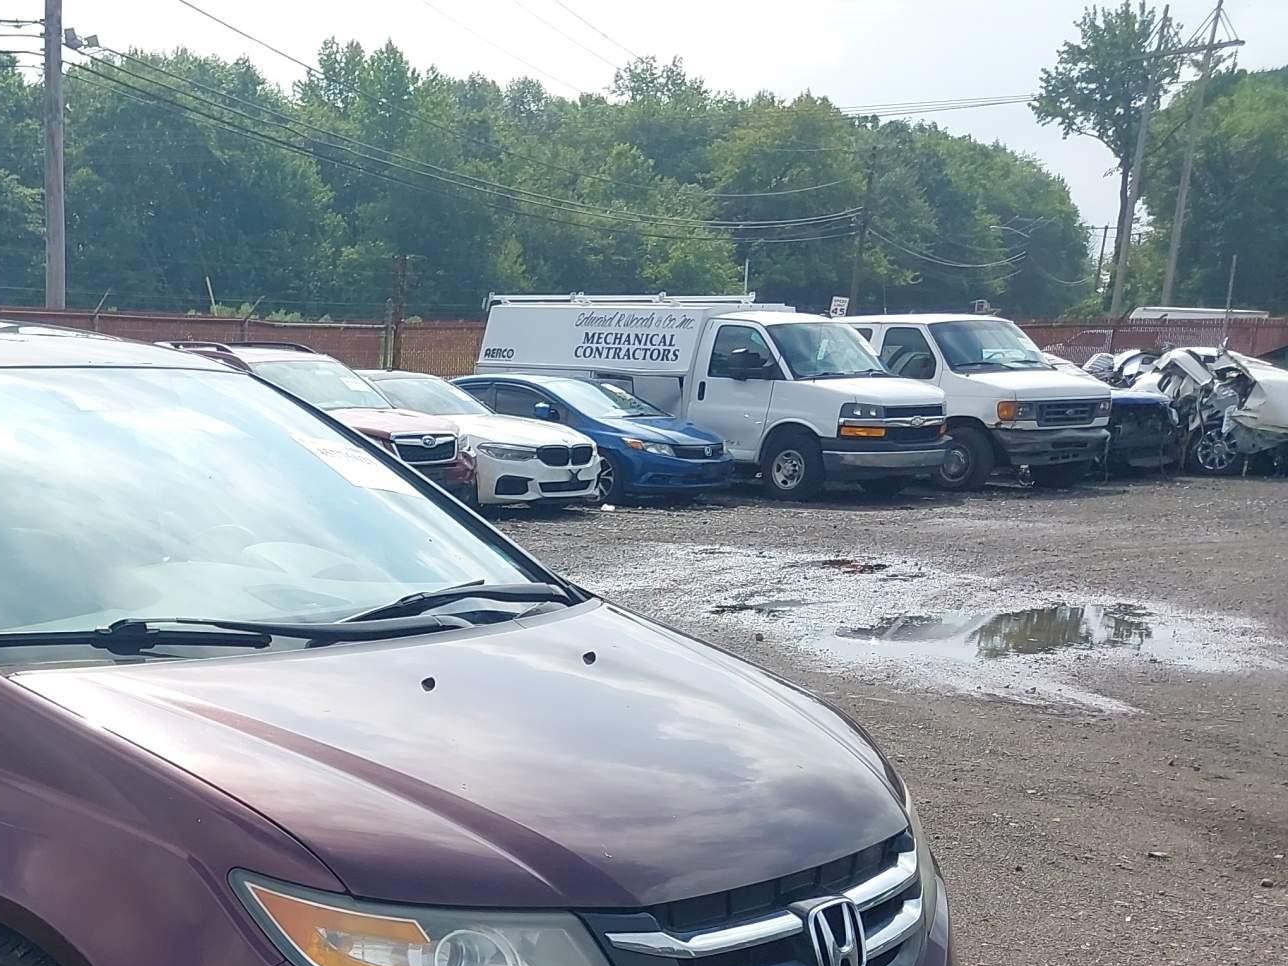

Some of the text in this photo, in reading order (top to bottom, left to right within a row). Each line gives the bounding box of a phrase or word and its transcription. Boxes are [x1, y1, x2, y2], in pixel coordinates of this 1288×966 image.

[832, 307, 845, 315] 45
[575, 311, 619, 328] Edward
[582, 332, 676, 347] MECHANICAL
[574, 345, 680, 362] CONTRACTORS
